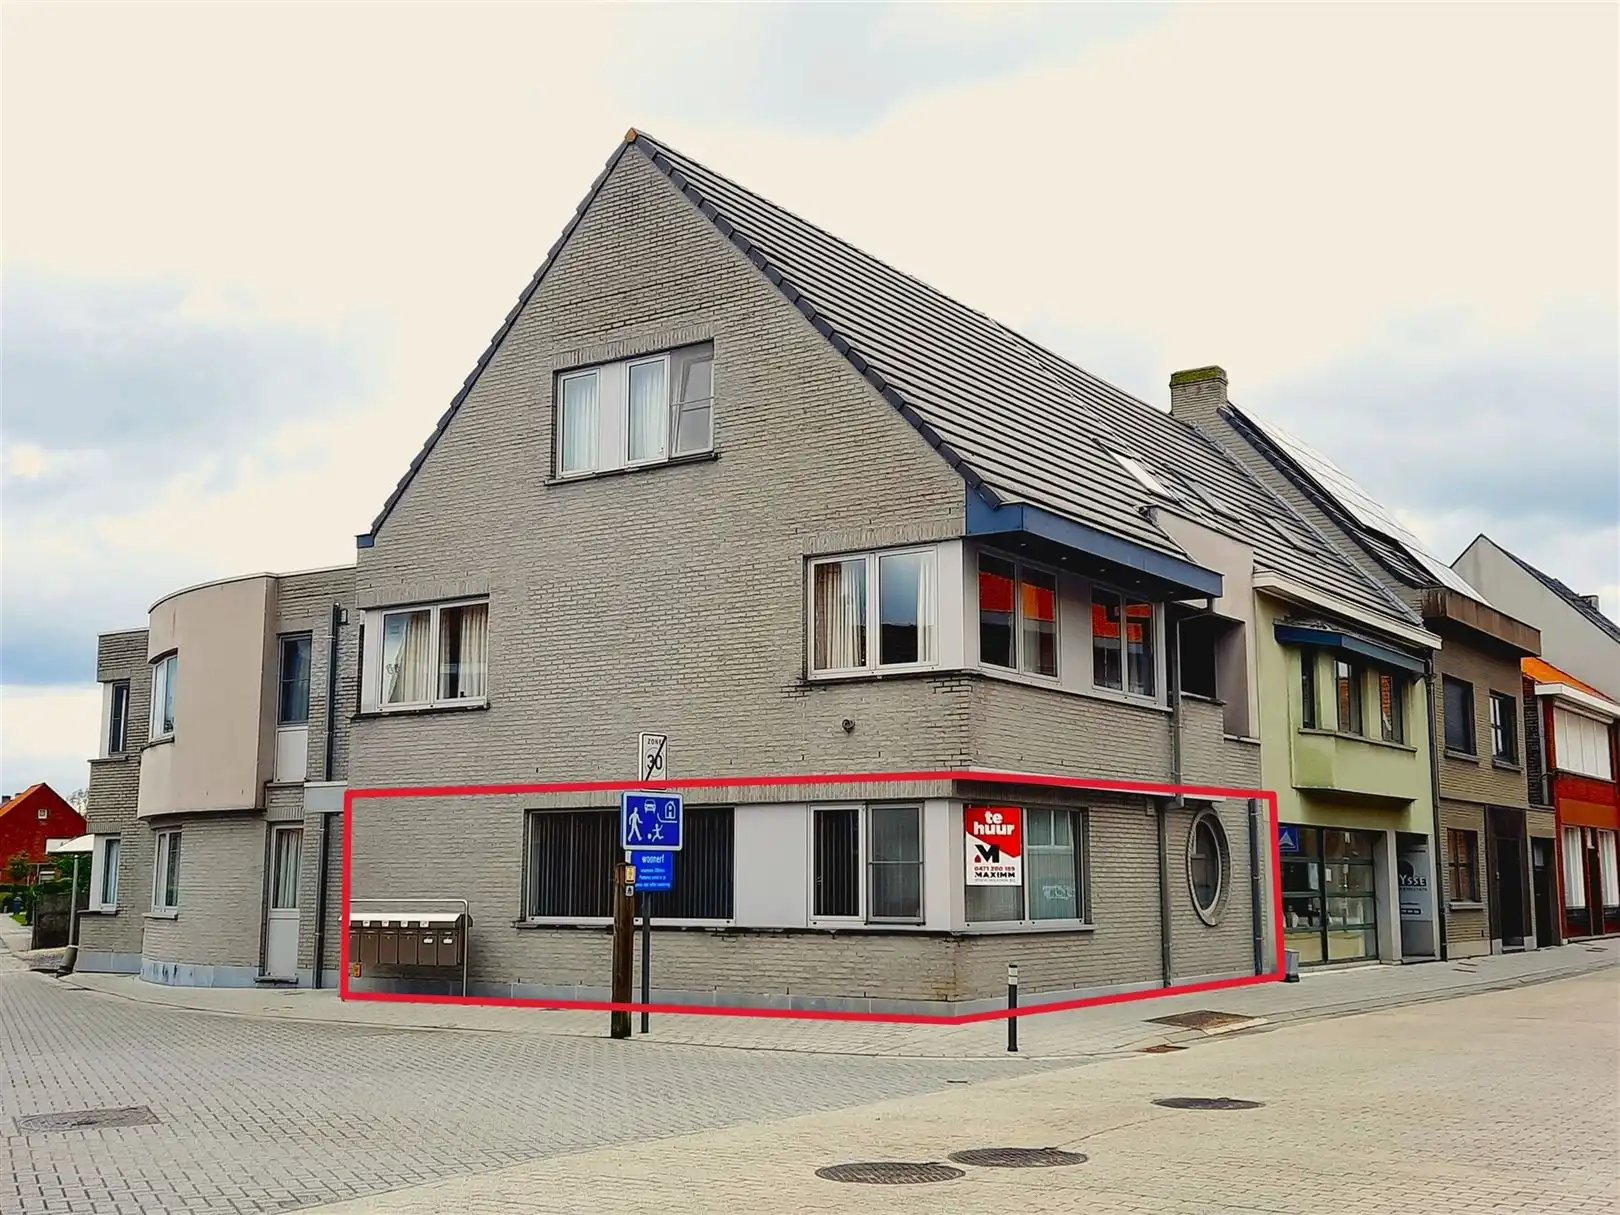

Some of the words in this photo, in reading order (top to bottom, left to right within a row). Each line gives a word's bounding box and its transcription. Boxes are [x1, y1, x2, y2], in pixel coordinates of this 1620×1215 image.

[647, 754, 662, 770] 30
[985, 811, 1003, 824] te
[973, 821, 1015, 835] huur
[641, 853, 665, 864] woonerf
